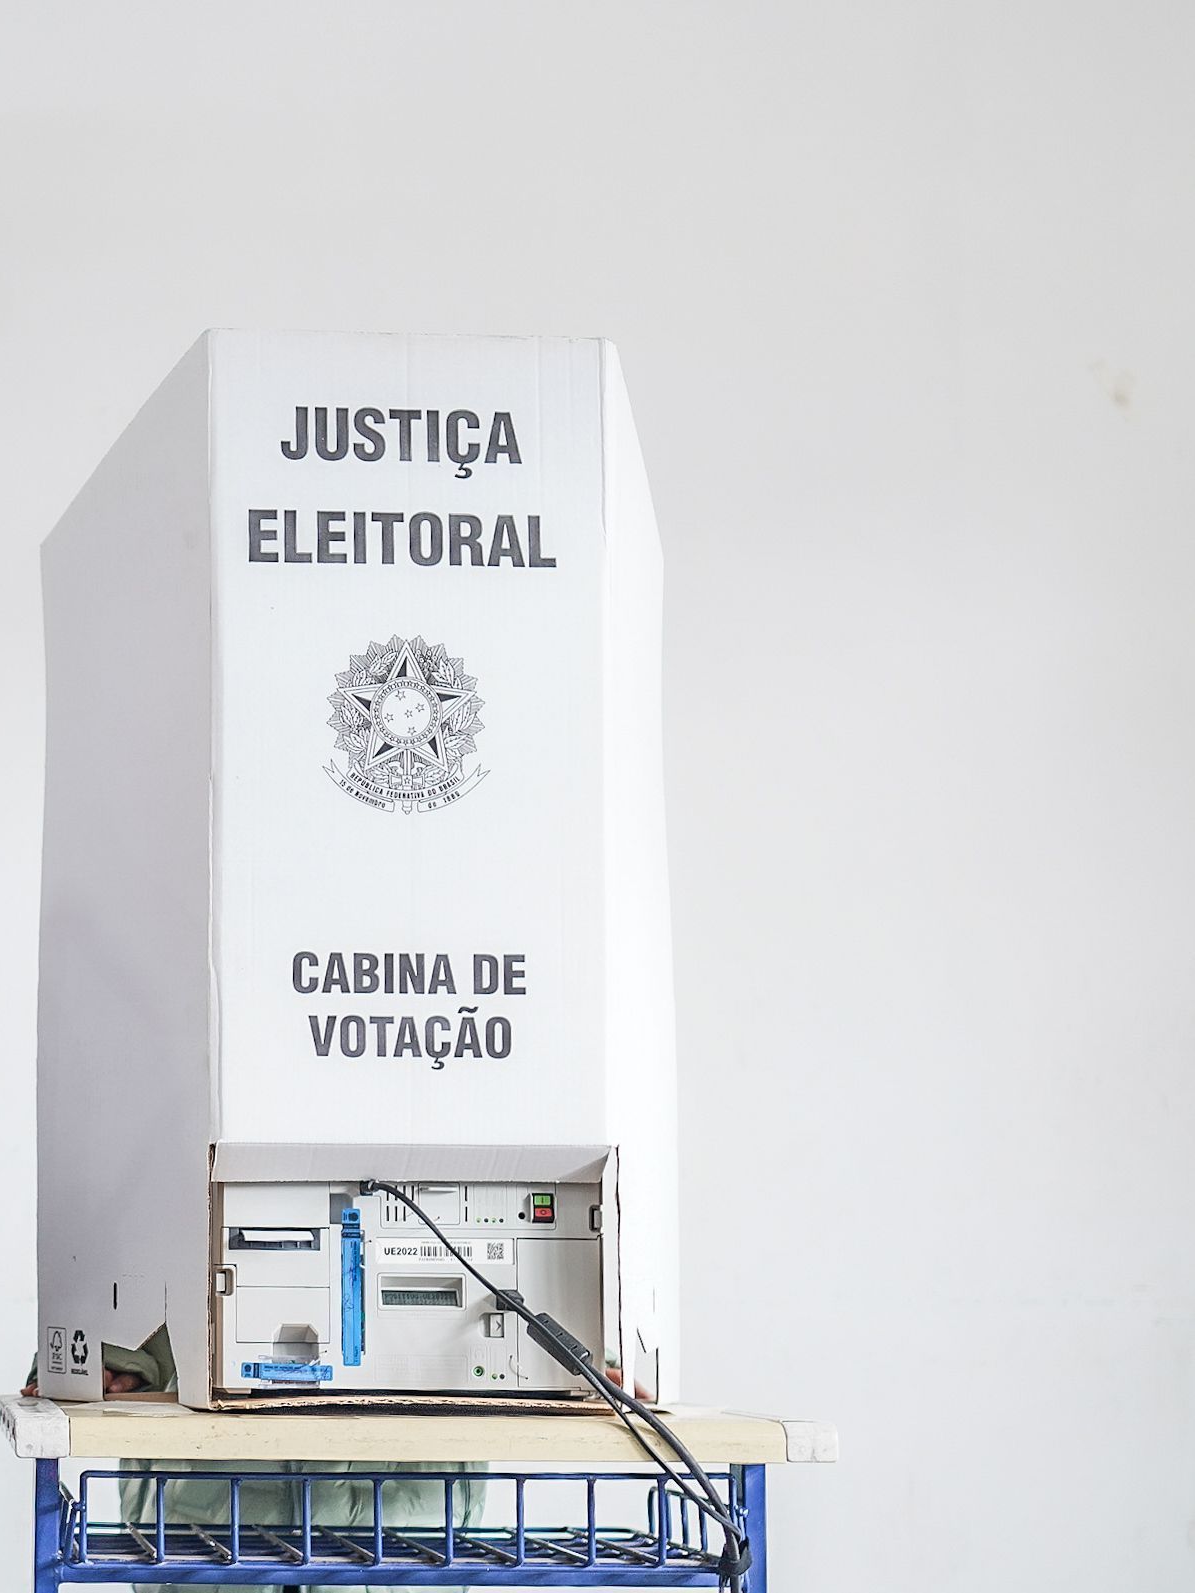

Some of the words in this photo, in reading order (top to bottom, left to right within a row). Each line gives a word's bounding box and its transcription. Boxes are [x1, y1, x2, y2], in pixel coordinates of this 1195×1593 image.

[280, 405, 522, 479] JUSTIÇA
[248, 508, 557, 568] ELEITORAL
[439, 776, 460, 792] BRASIL
[292, 951, 457, 995] CABINA
[473, 953, 527, 996] DE
[308, 1005, 512, 1070] VOTAÇÃO
[384, 1247, 418, 1256] UE2022
